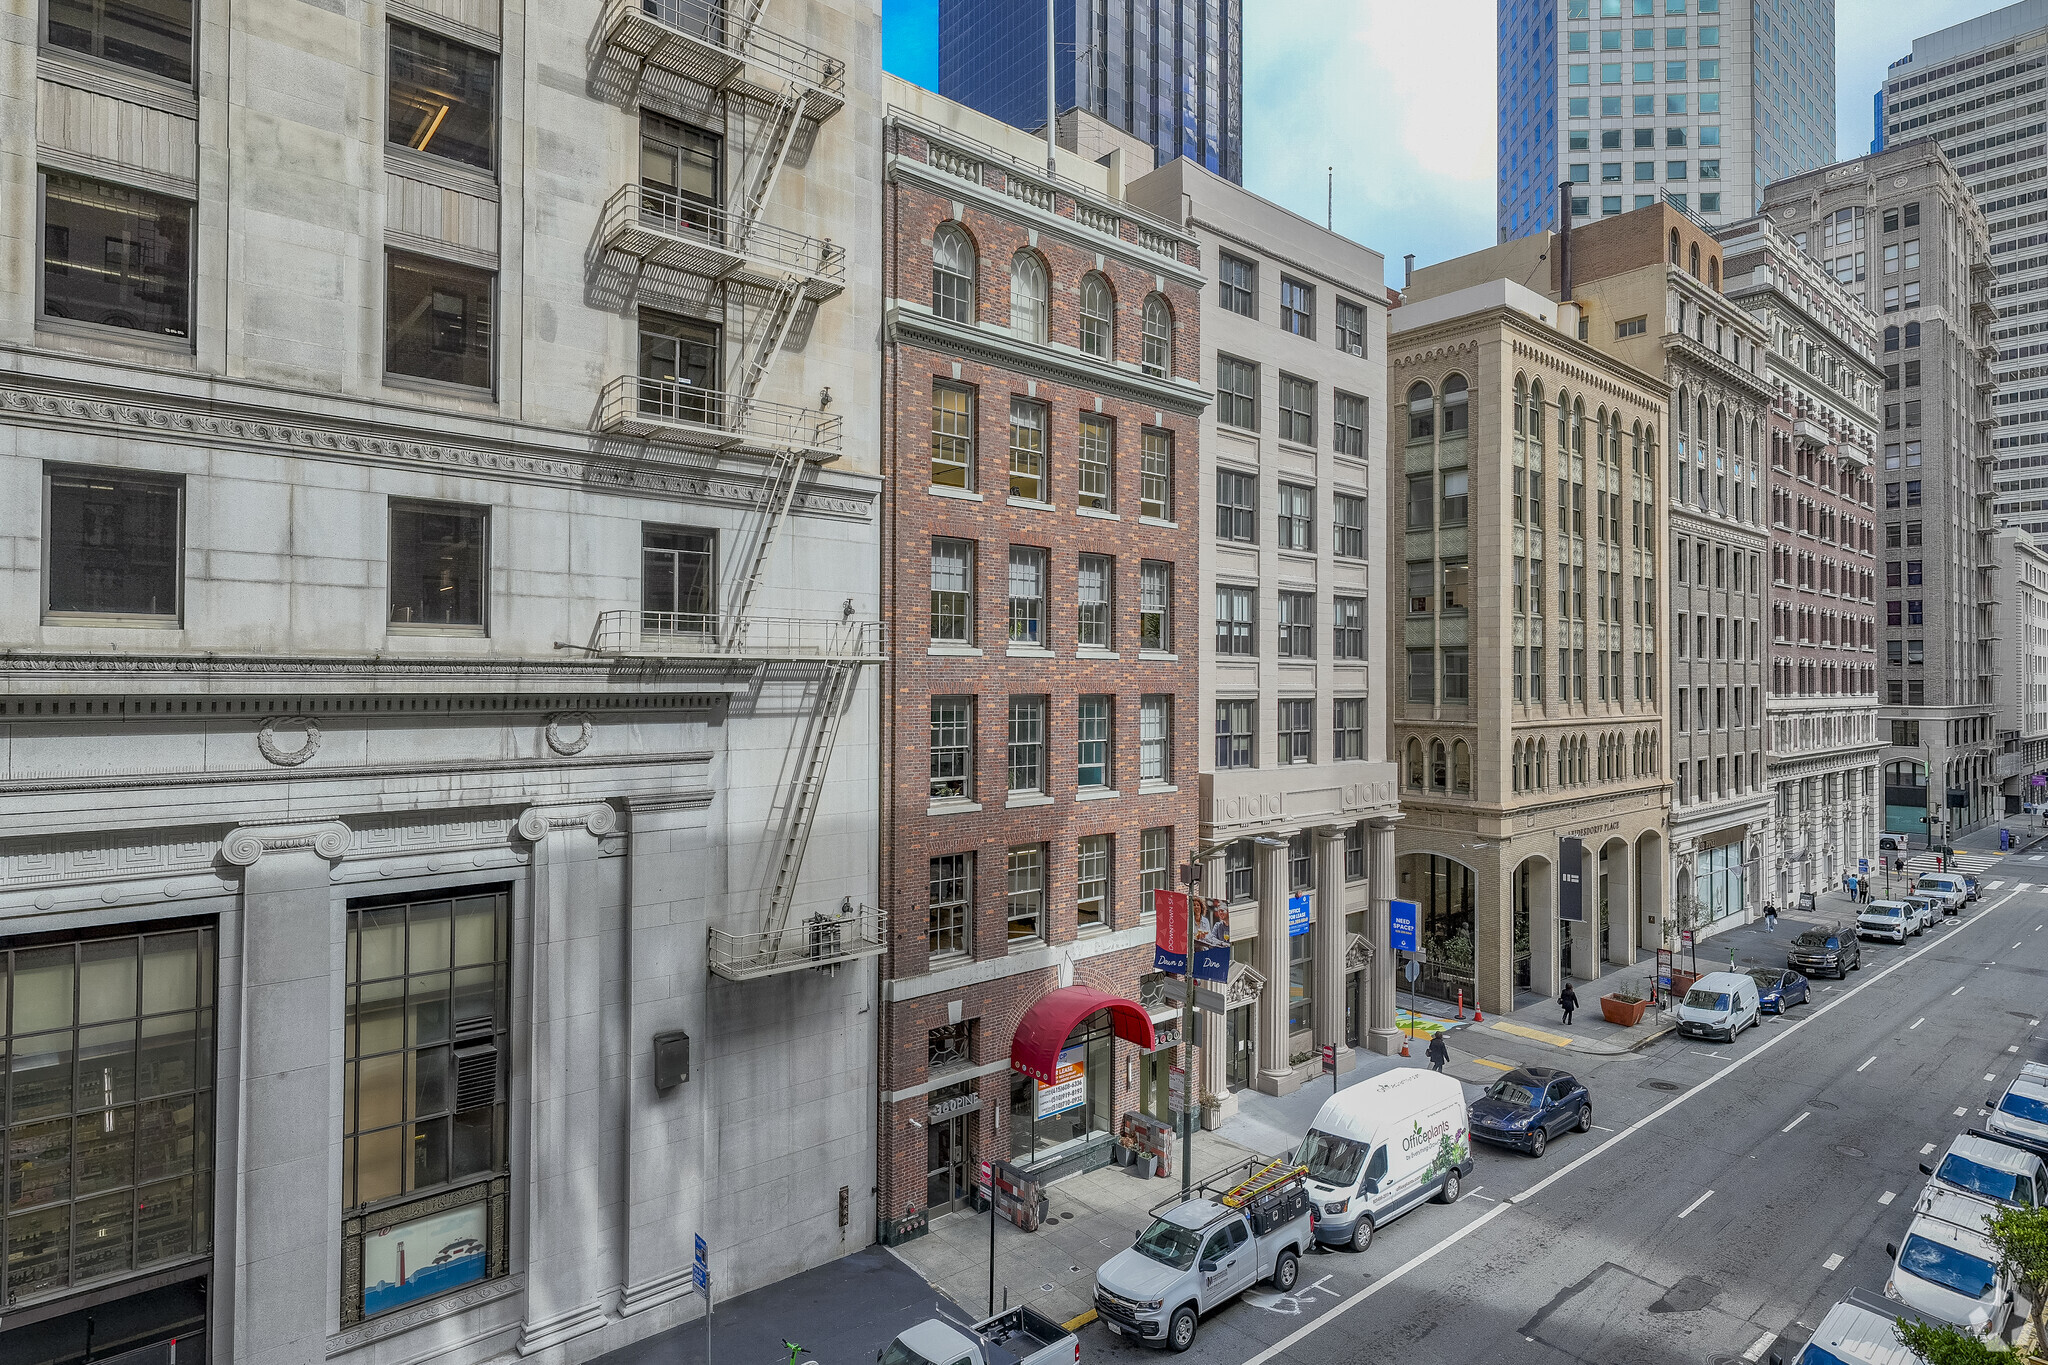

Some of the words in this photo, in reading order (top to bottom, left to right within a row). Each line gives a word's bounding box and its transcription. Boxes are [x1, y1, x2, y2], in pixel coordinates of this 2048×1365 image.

[1395, 917, 1411, 925] NEED
[1392, 923, 1415, 932] SPACE?
[1158, 955, 1177, 966] Down
[1178, 959, 1184, 967] to
[1203, 957, 1221, 969] Dine
[1059, 1065, 1073, 1074] LEASE
[1402, 1121, 1450, 1152] Officeplants
